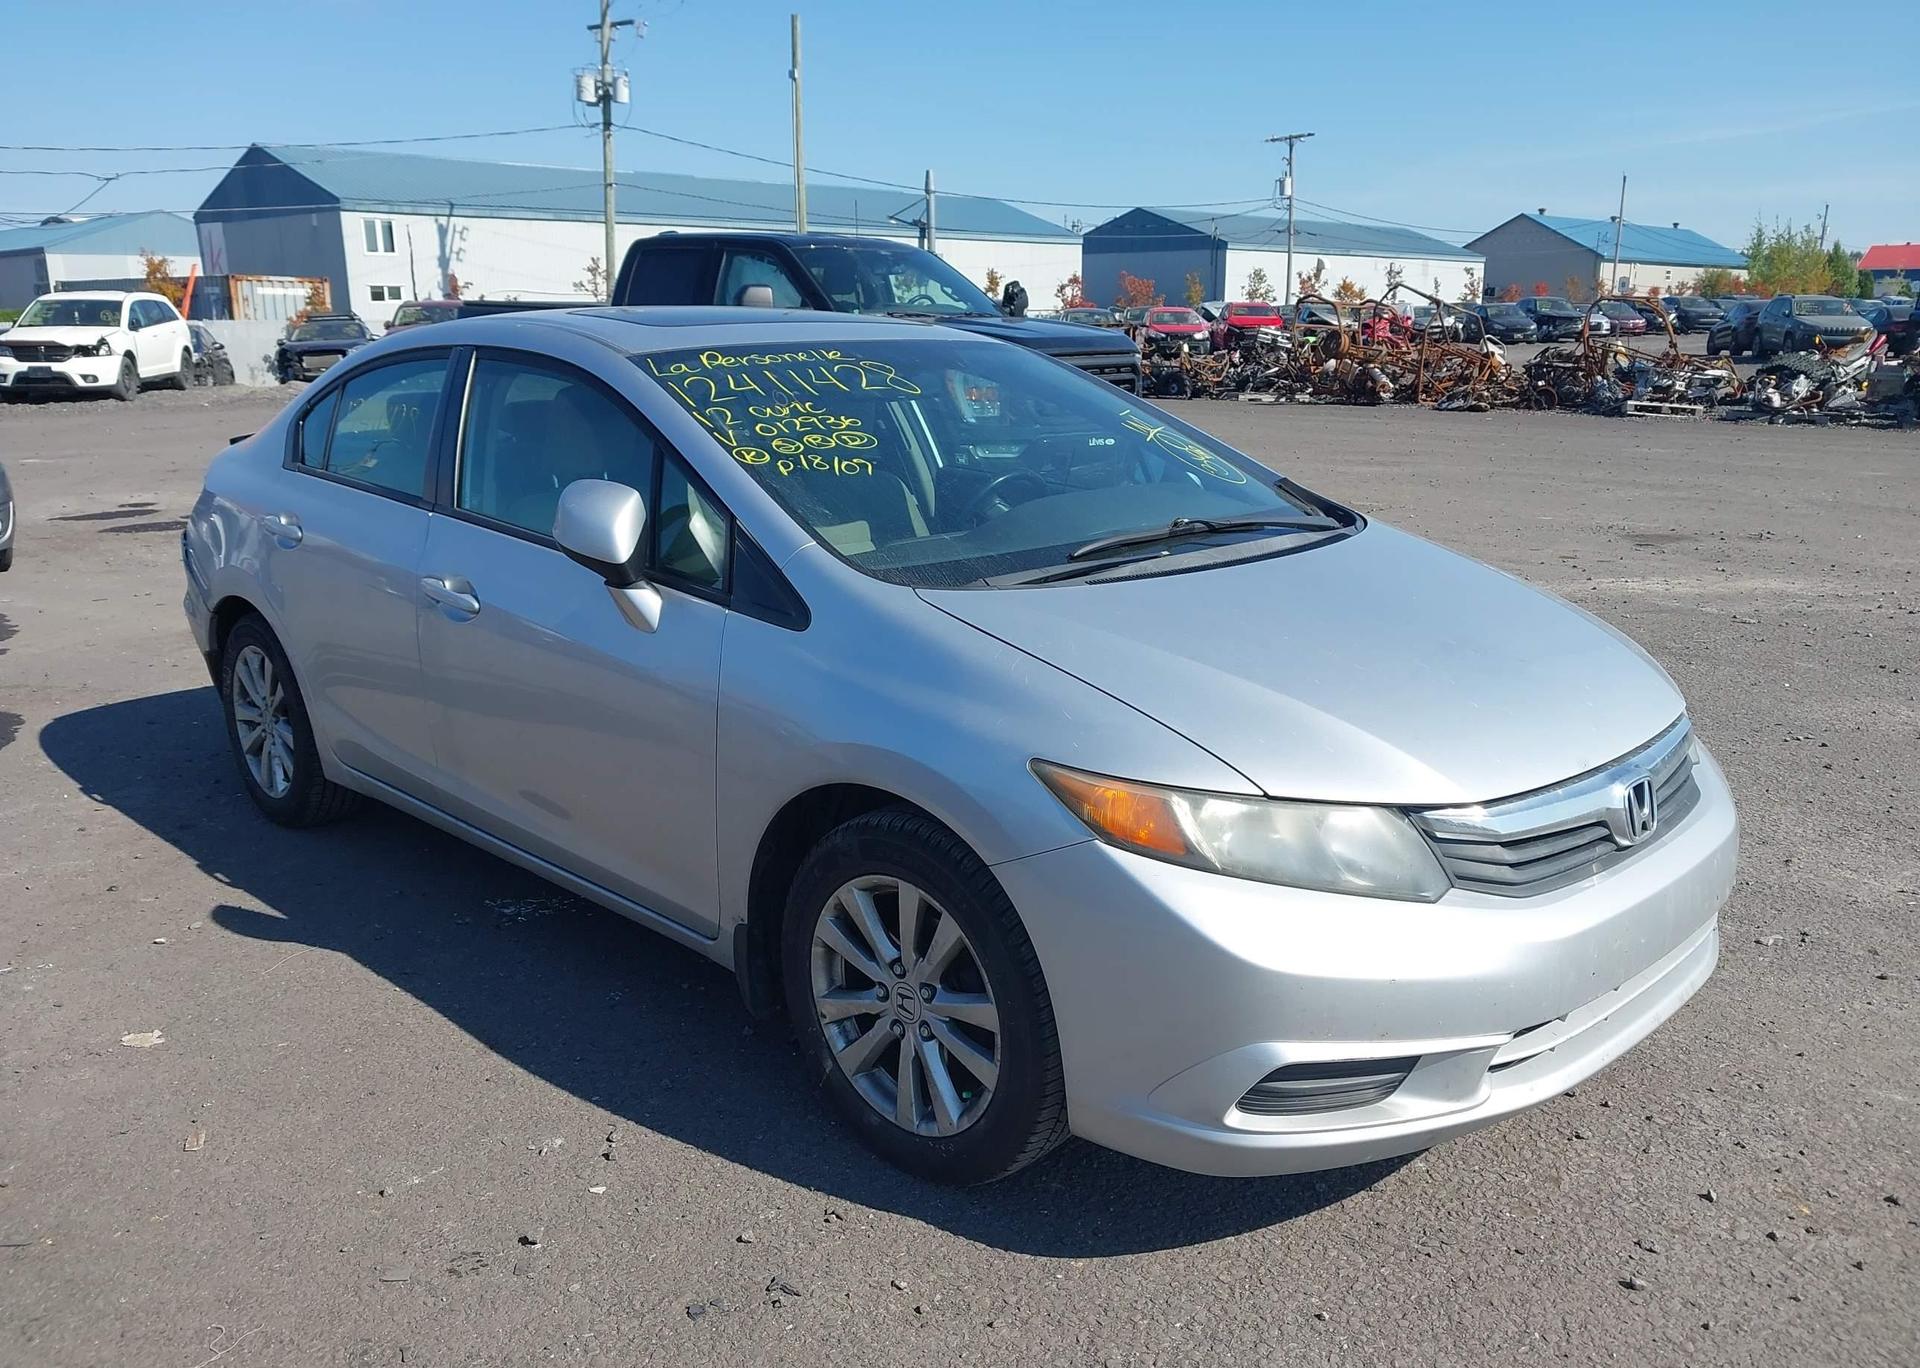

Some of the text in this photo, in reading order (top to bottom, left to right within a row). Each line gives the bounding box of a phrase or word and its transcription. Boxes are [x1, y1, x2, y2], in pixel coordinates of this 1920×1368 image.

[648, 359, 700, 376] La
[668, 361, 921, 407] 12411428
[693, 407, 743, 427] 12
